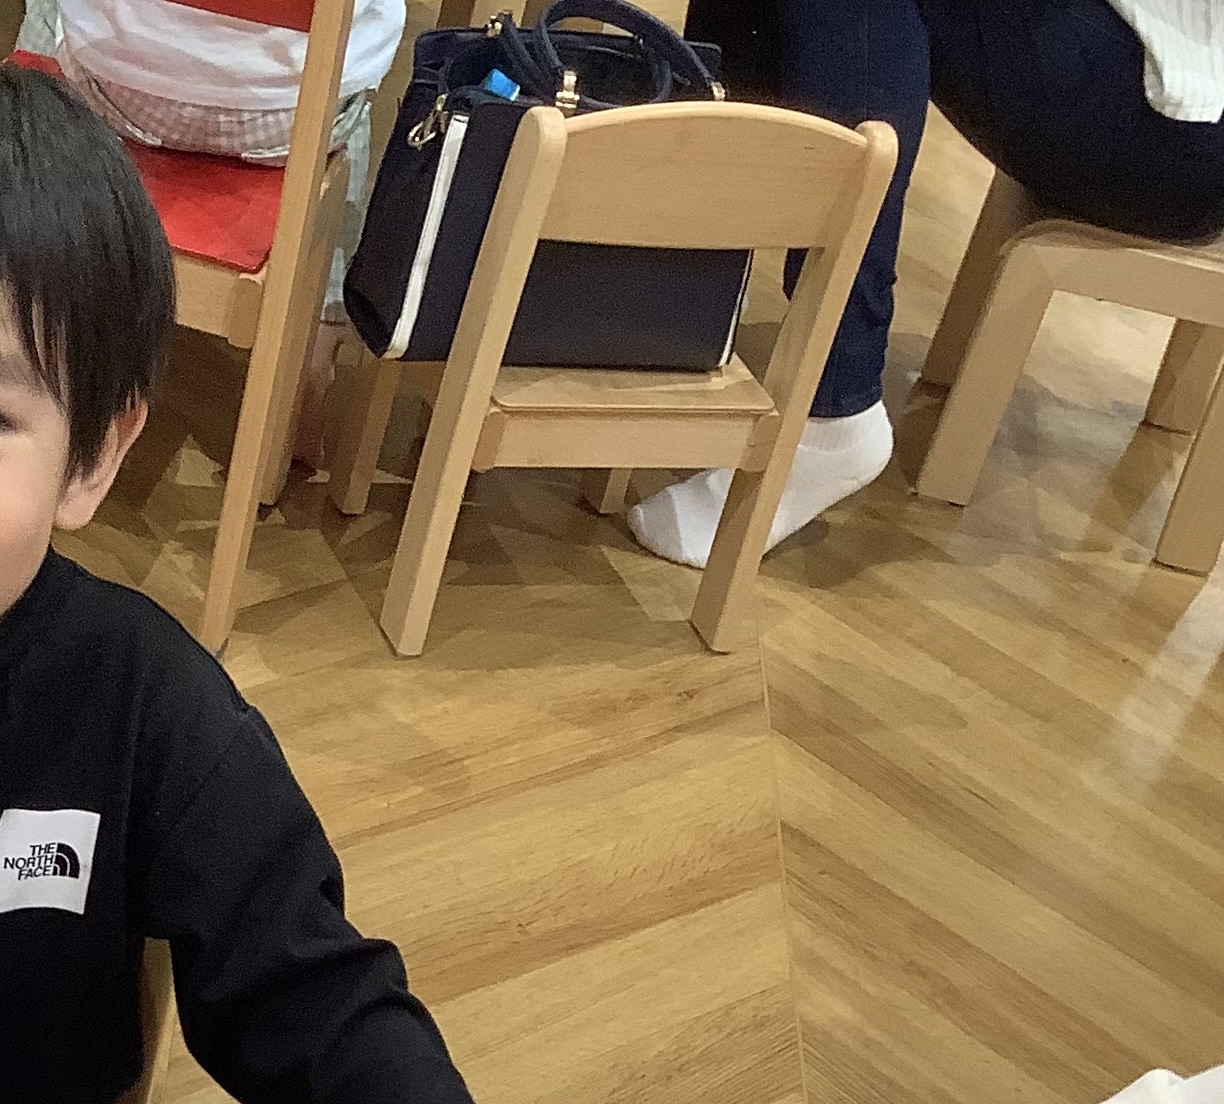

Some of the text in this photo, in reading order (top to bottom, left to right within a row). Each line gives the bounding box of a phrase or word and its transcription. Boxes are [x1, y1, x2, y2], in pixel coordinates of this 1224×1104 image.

[30, 842, 56, 856] THE
[3, 854, 54, 870] NORTH
[17, 865, 51, 880] FACE
